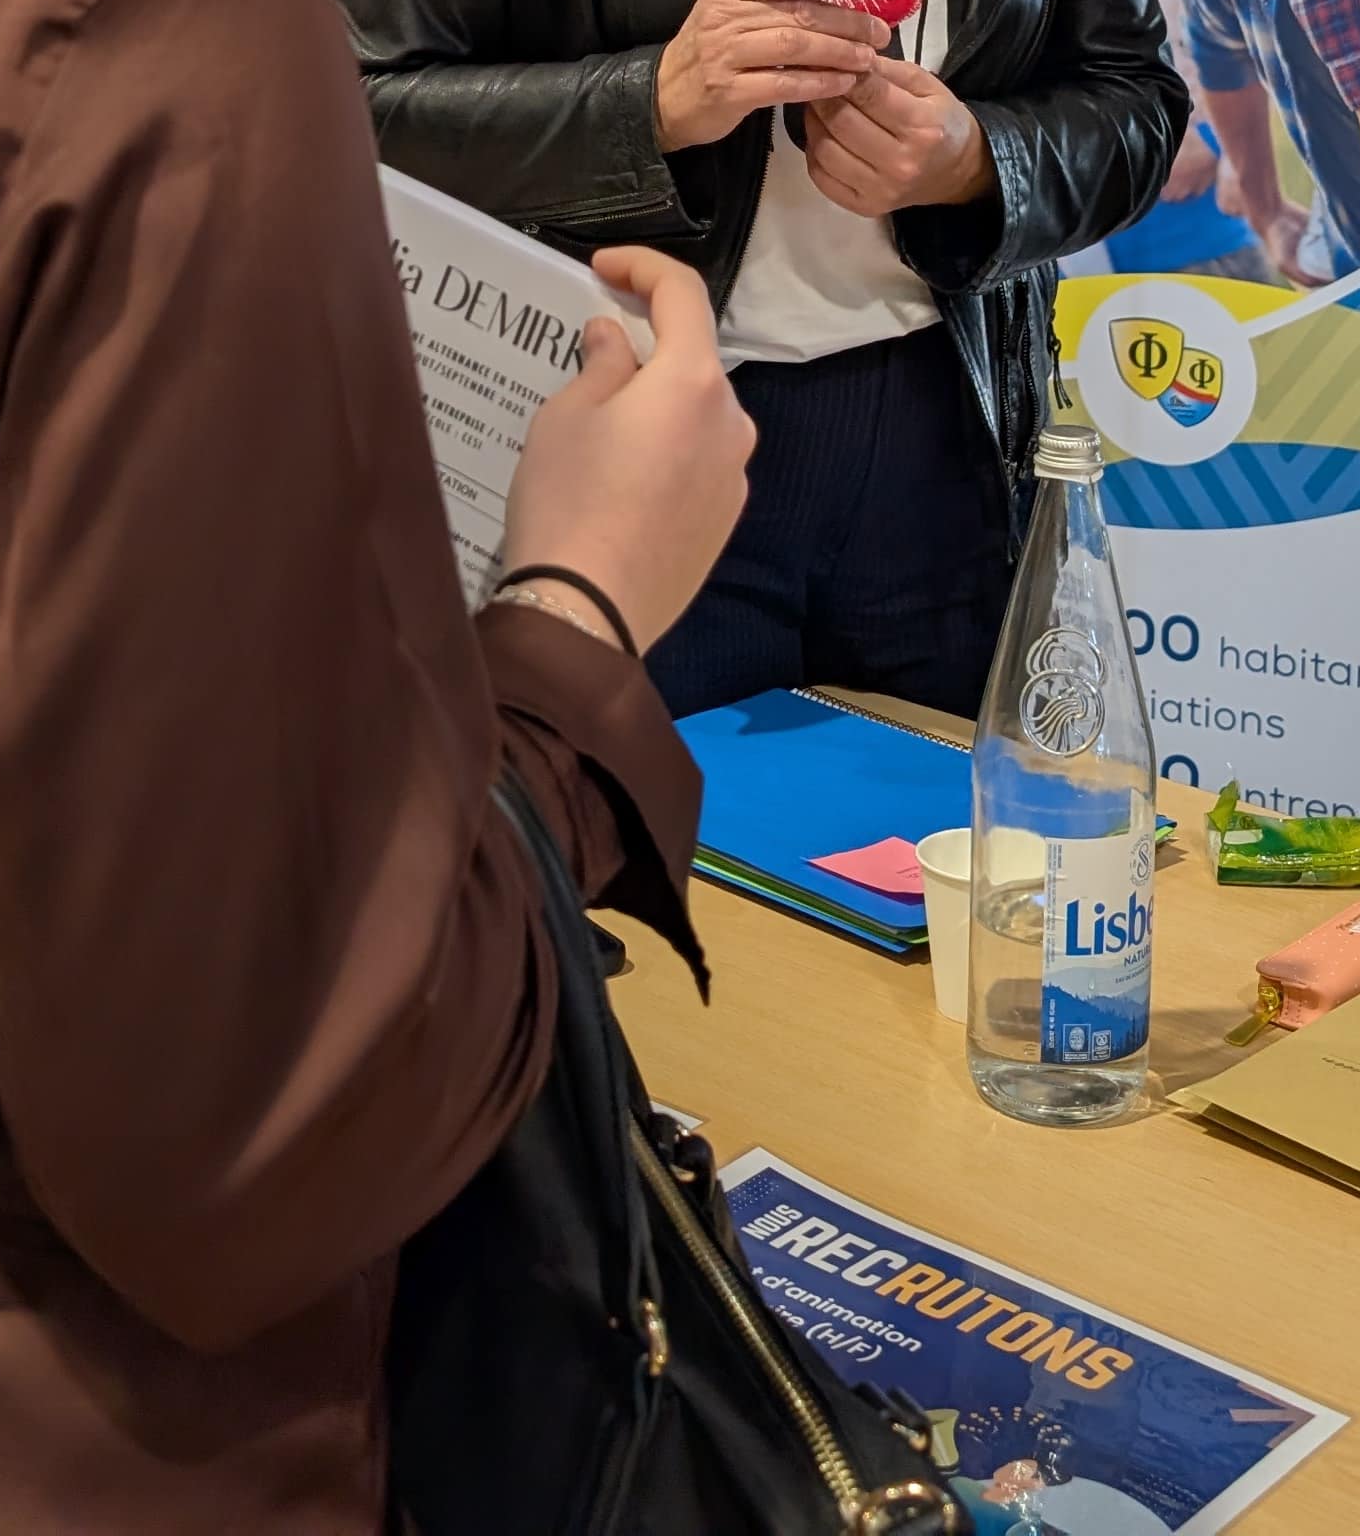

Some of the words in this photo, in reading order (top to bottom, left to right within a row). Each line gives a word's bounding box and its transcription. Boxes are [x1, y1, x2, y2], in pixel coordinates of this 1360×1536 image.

[416, 351, 496, 401] OUT/SEPTEMBRE
[1150, 689, 1286, 739] iations
[741, 1204, 803, 1241] NOUS
[761, 1275, 923, 1353] d'animation
[768, 1216, 1134, 1390] RECRUTONS
[804, 1321, 883, 1363] (H/F)
